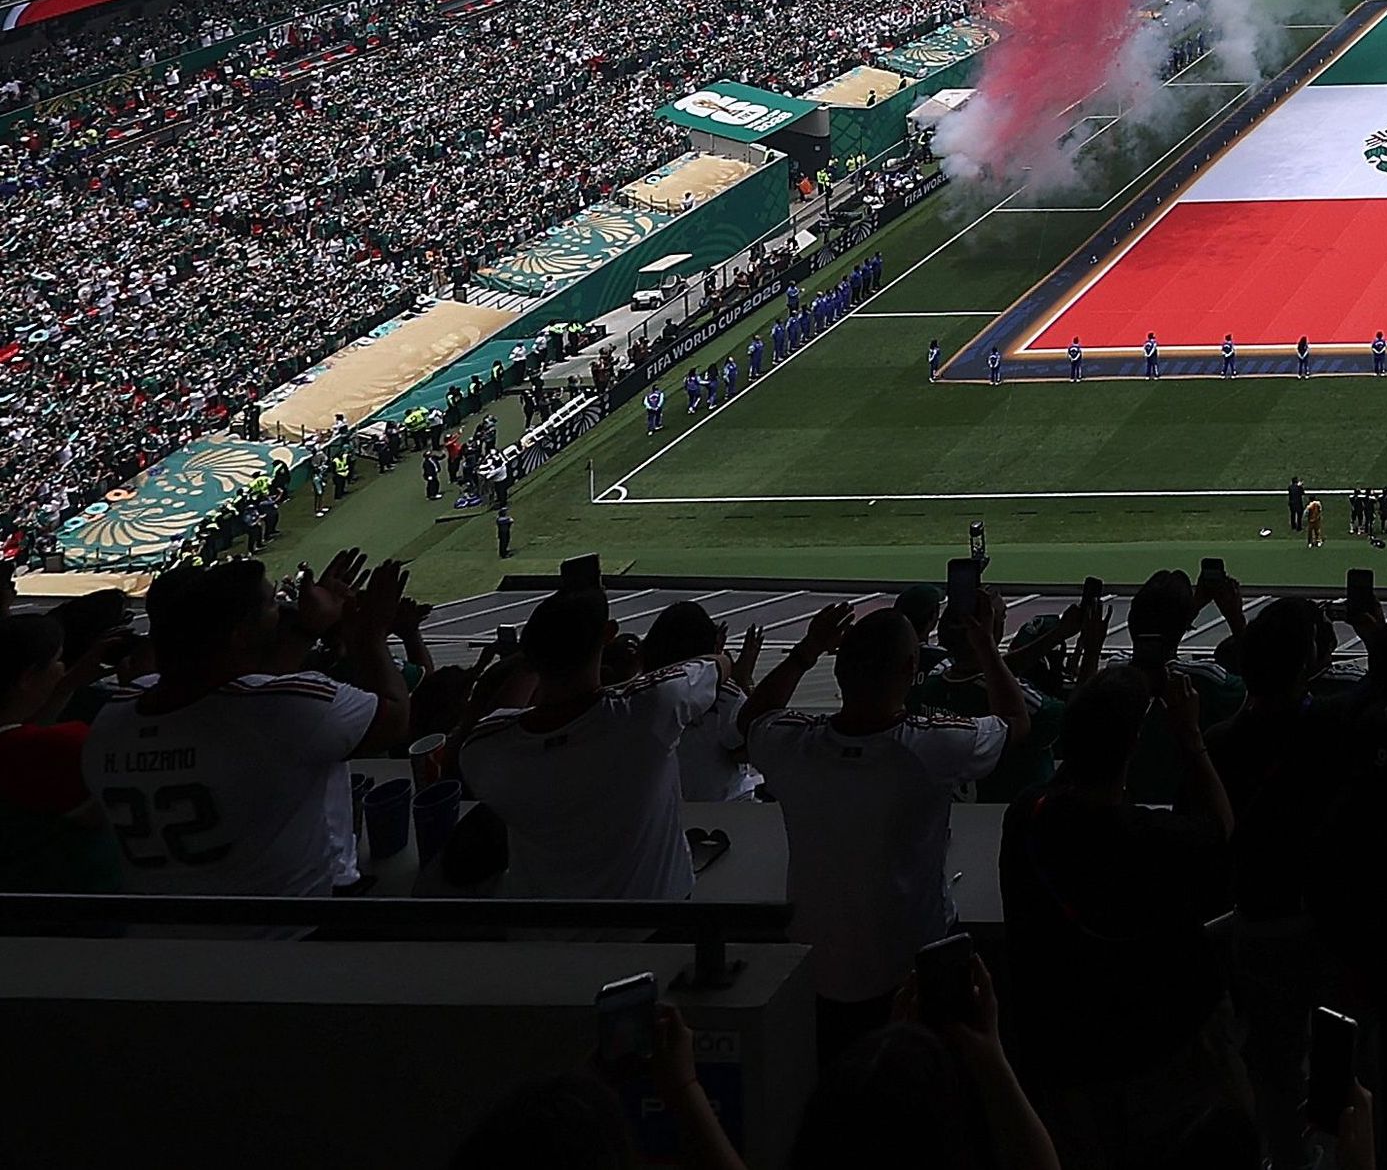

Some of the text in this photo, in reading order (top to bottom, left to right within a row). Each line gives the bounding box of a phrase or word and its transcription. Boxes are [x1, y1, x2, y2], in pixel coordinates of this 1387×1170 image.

[904, 188, 923, 208] FIFA
[646, 281, 782, 380] FIFA WORLD CUP 2026
[126, 747, 196, 773] LOZANO
[102, 783, 232, 868] 22
